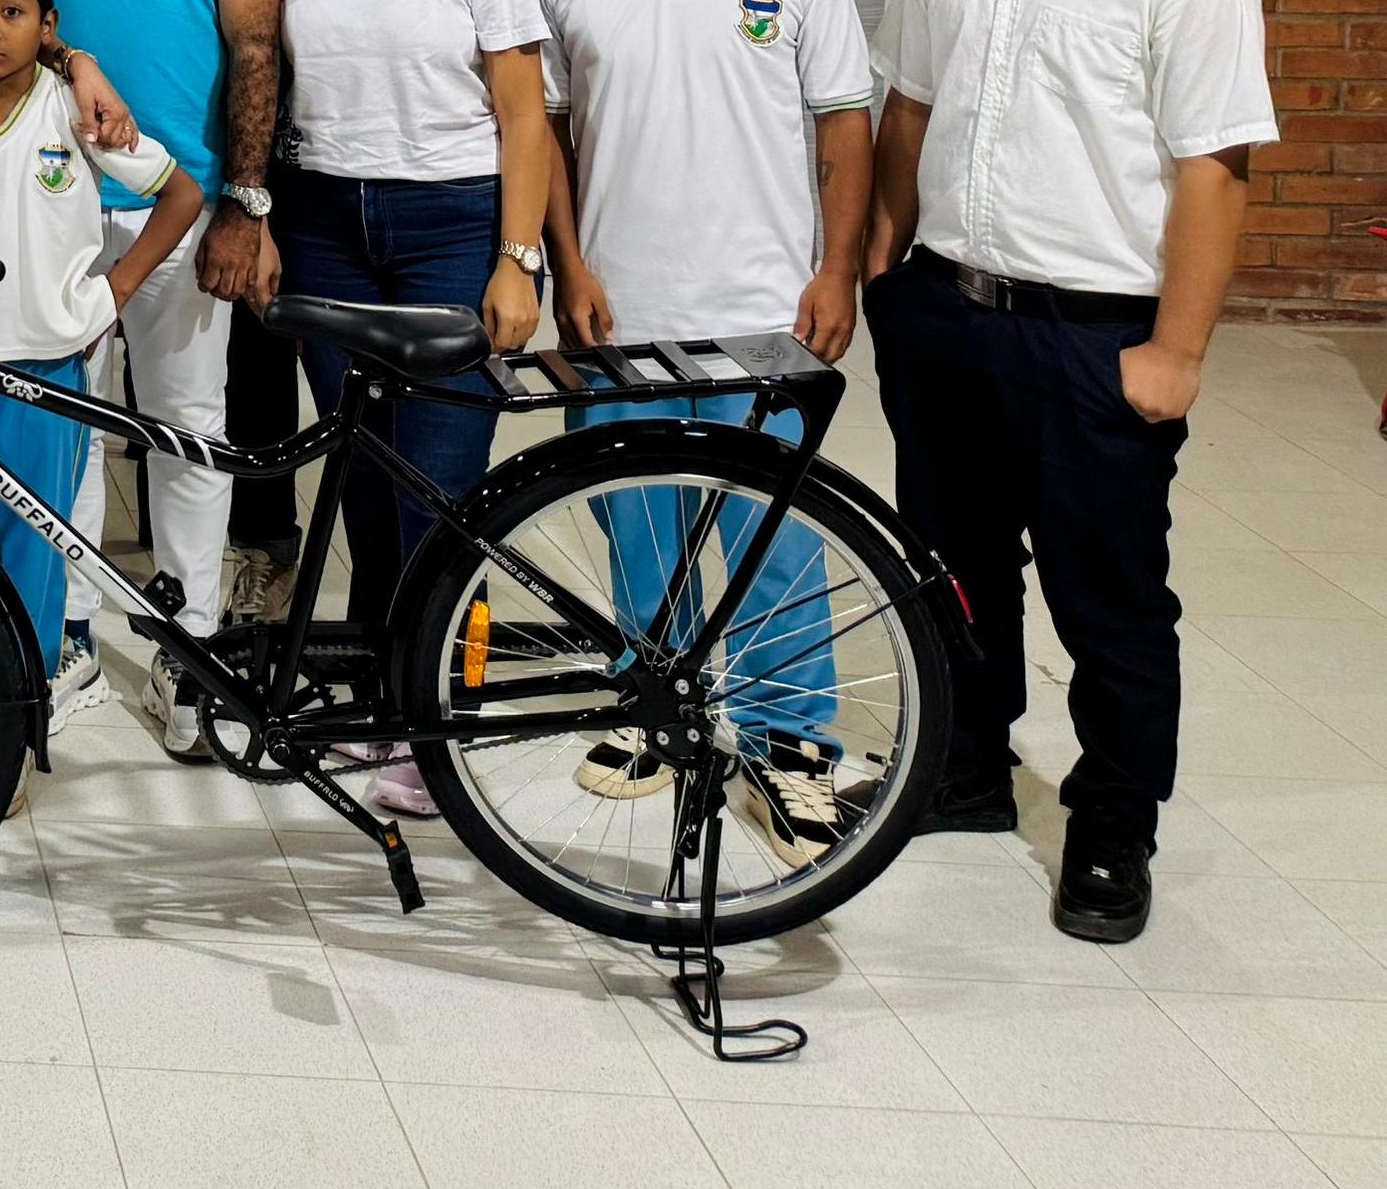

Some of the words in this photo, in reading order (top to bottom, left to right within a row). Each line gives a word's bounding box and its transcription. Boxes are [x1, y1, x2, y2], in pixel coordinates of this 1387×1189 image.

[474, 537, 518, 573] POWERED
[516, 571, 531, 583] BY
[528, 581, 555, 603] WBR
[303, 770, 339, 801] BUFFALO
